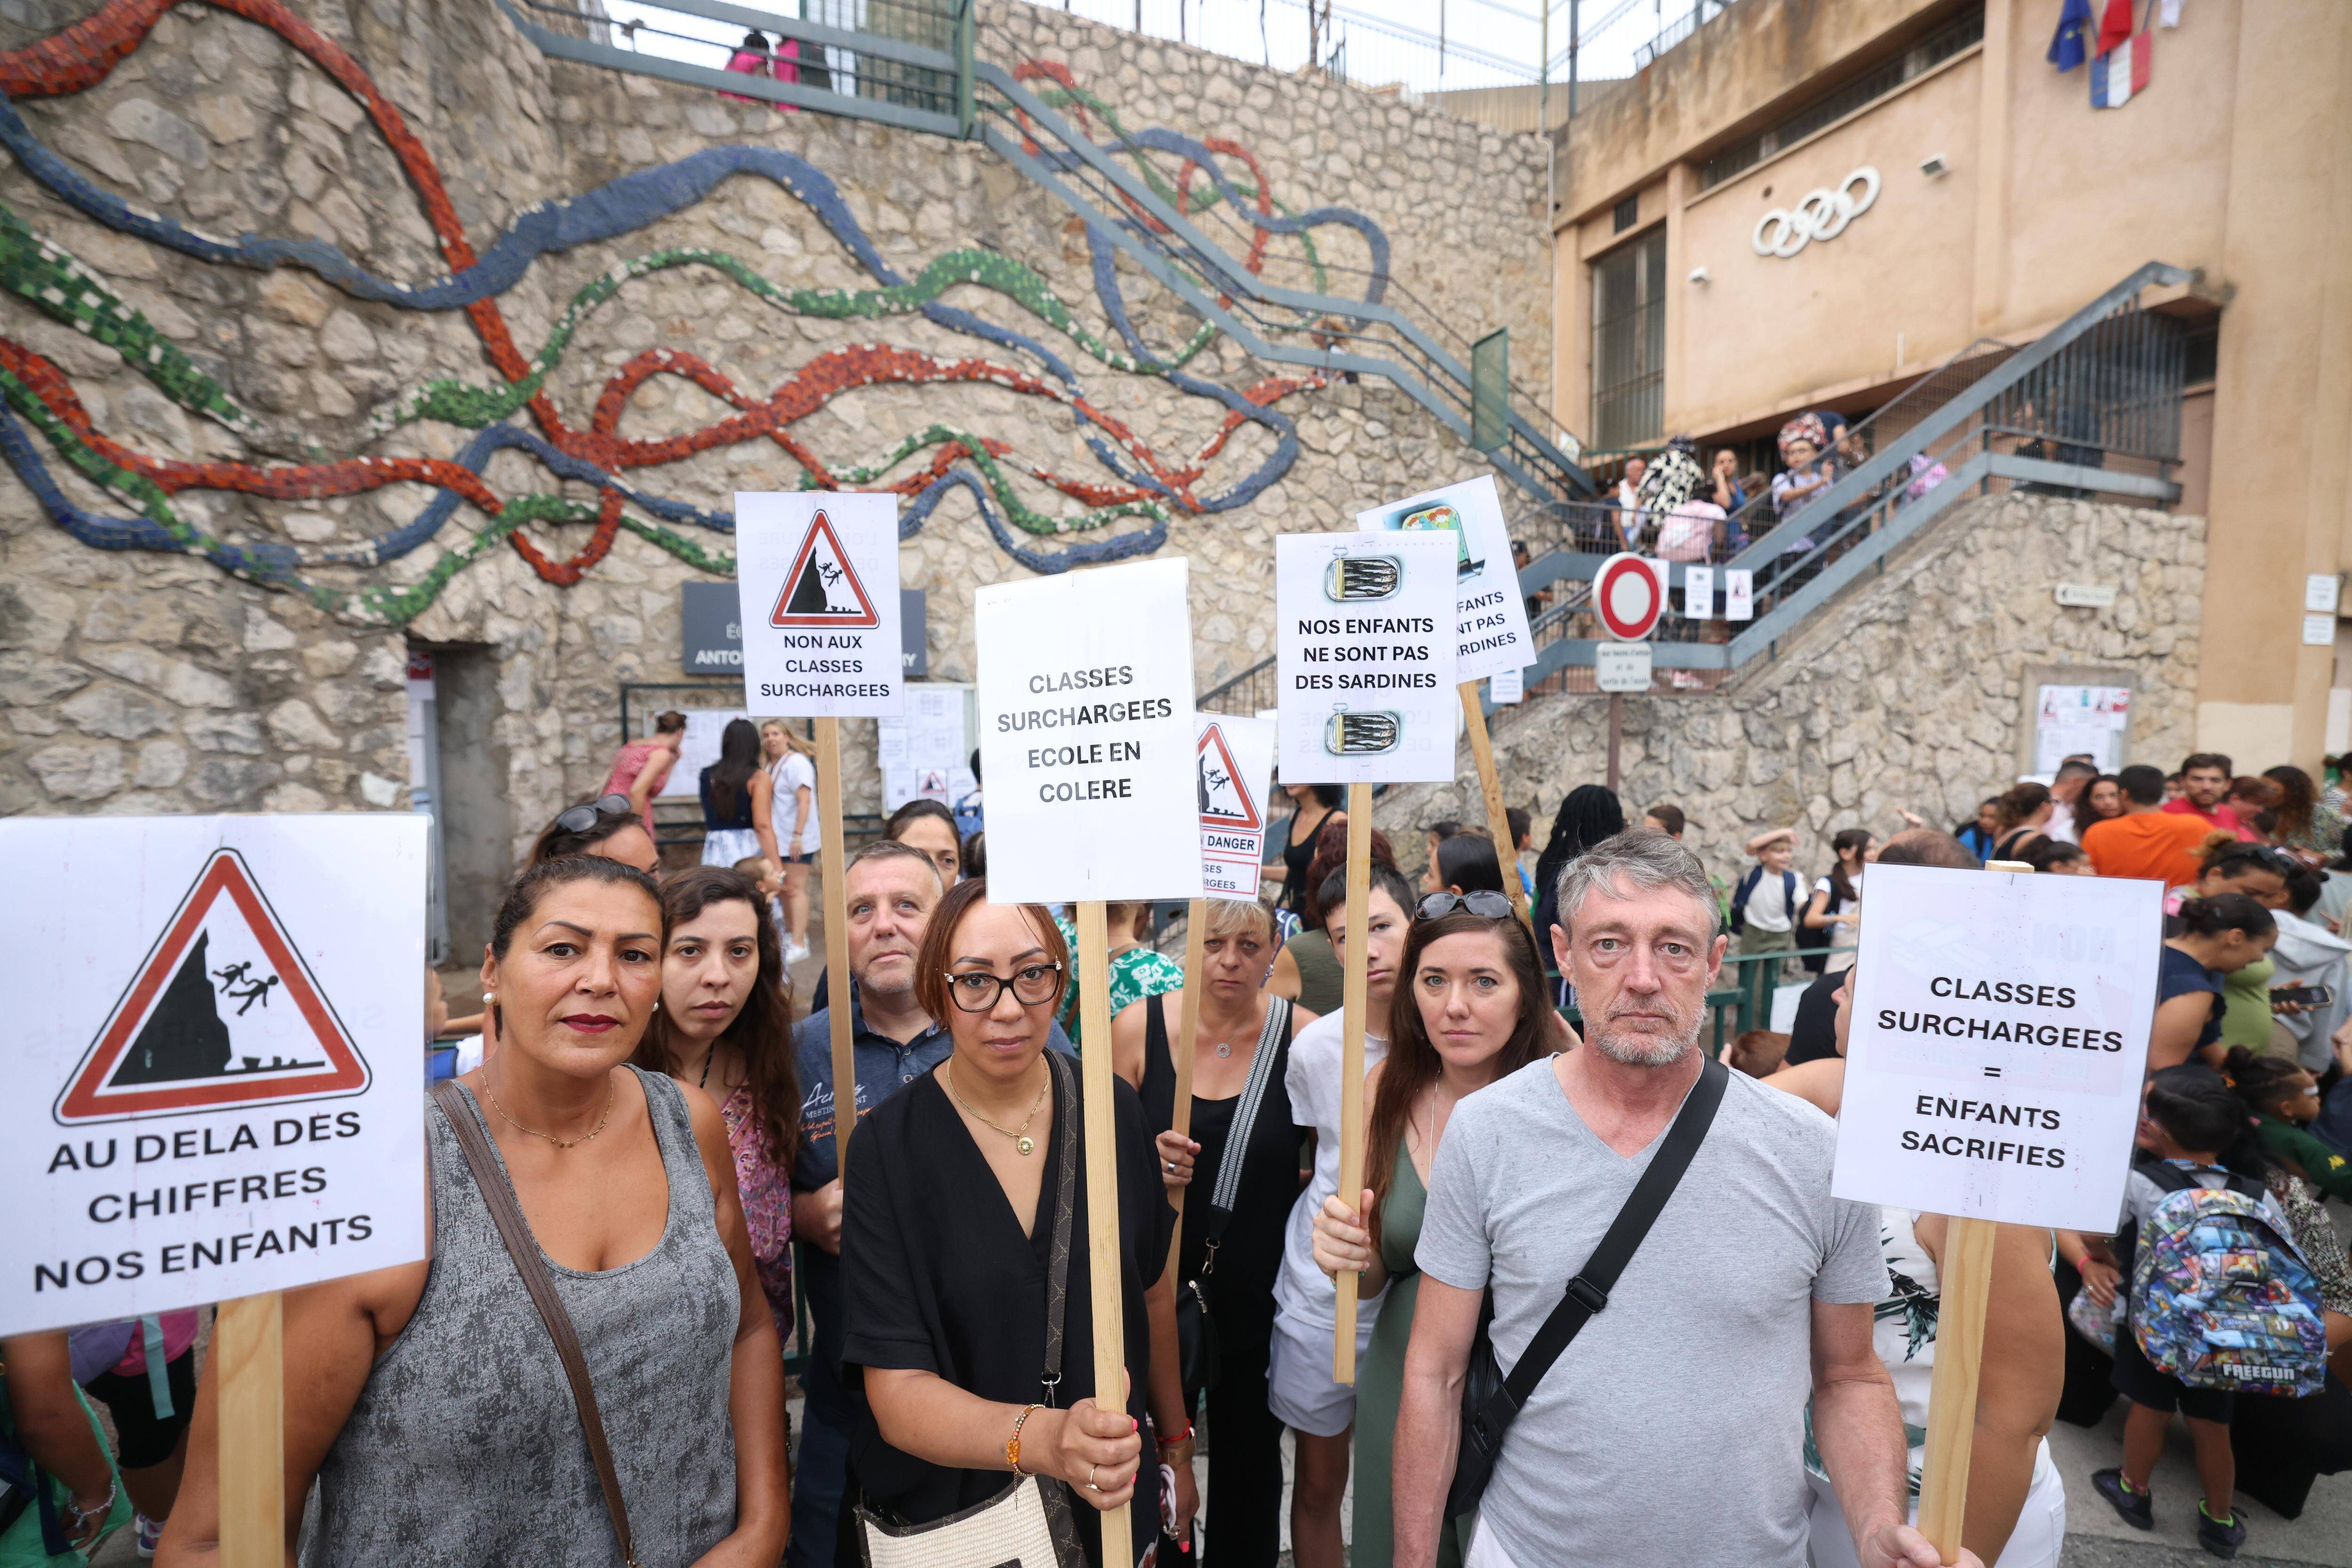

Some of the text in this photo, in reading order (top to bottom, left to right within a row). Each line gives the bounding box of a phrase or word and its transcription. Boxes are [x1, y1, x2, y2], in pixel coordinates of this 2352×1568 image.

[1459, 591, 1504, 613] FANTS
[1299, 618, 1433, 635] NOS ENFANTS
[1476, 613, 1505, 630] PAS
[784, 636, 862, 649] NON AUX
[1304, 645, 1429, 662] NE SONT PAS
[1460, 632, 1517, 656] RDINES
[695, 650, 743, 665] ANTO
[786, 660, 863, 673] CLASSES
[761, 684, 890, 697] SURCHARGEES
[1029, 665, 1133, 694] CLASSES
[1296, 673, 1436, 689] DES SARDINES
[998, 698, 1172, 732] SURCHARGEES
[1028, 740, 1141, 768] ECOLE EN
[1040, 778, 1132, 803] COLERE
[1208, 836, 1255, 851] DANGER
[1931, 977, 2076, 1008] CLASSES
[1878, 1010, 2122, 1052] SURCHARGEES
[1984, 1067, 2001, 1077] =
[1916, 1095, 2060, 1130] ENFANTS
[48, 1112, 360, 1174] AU DELA DES
[1901, 1130, 2065, 1168] SACRIFIES
[88, 1167, 326, 1223] CHIFFRES
[35, 1215, 372, 1292] NOS ENFANTS
[2223, 1363, 2295, 1381] FREEGUN
